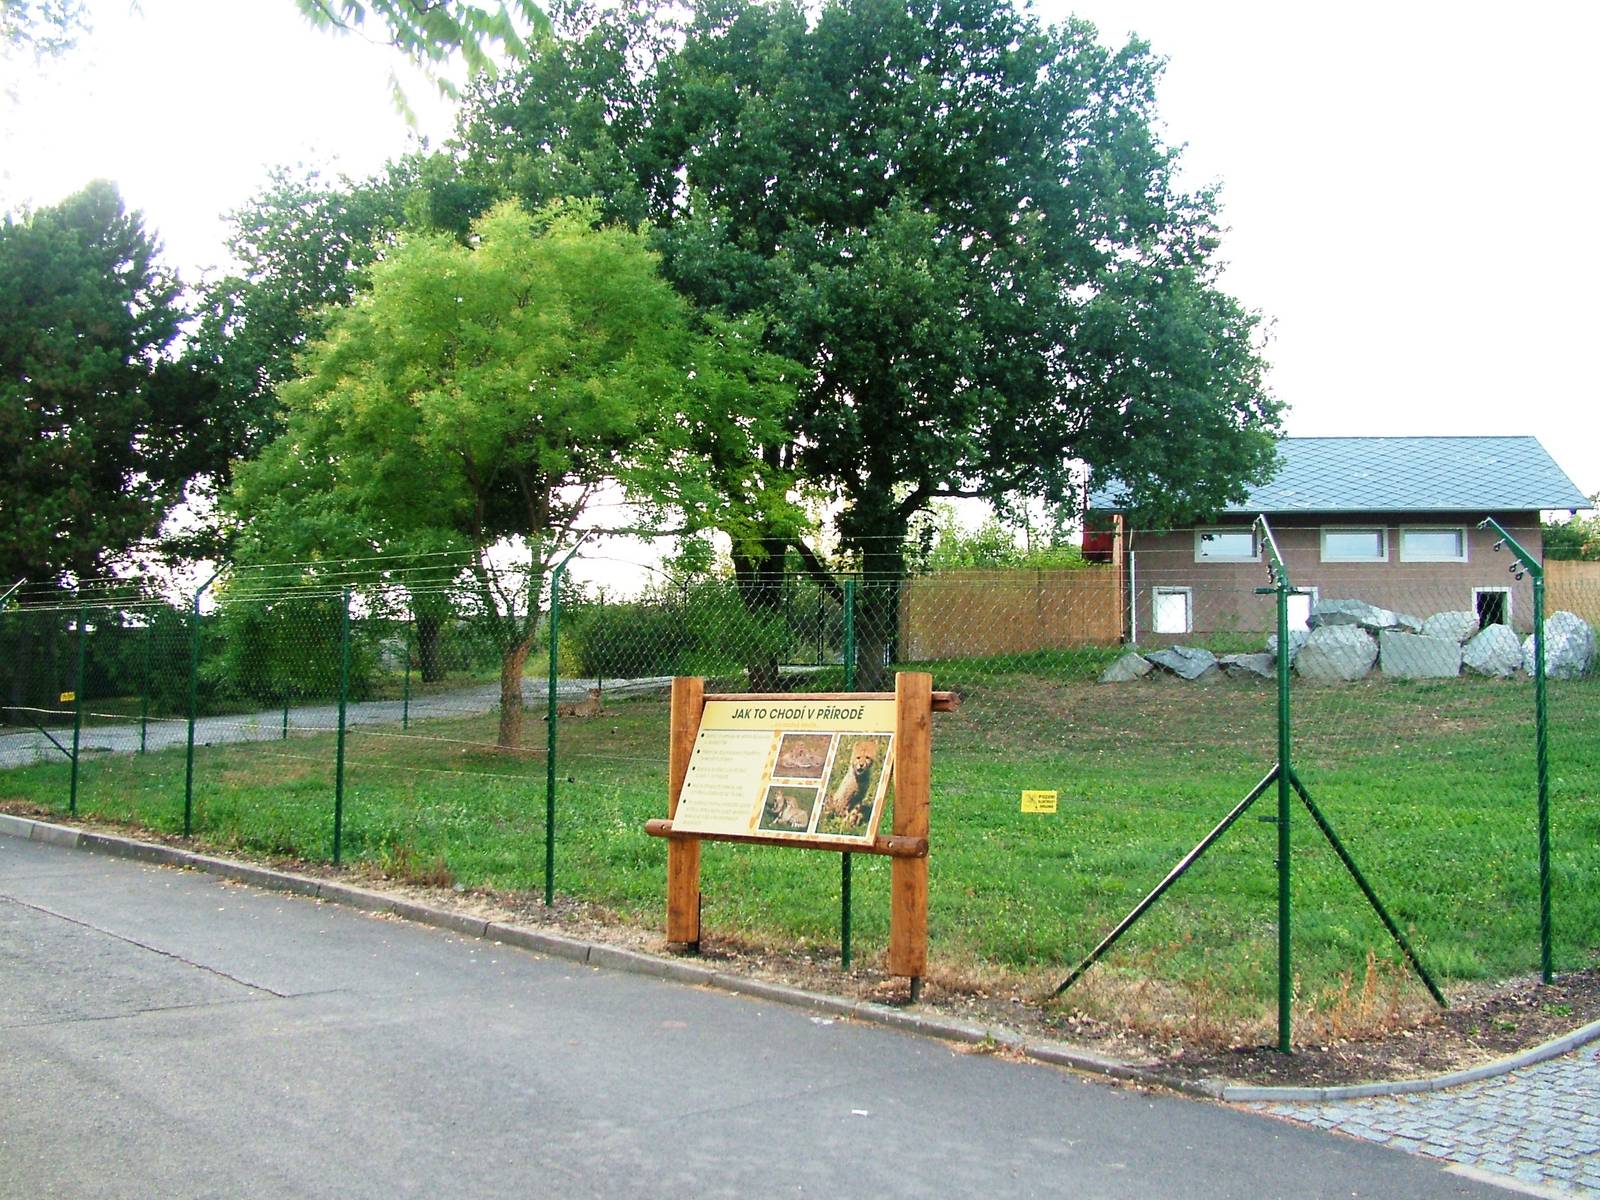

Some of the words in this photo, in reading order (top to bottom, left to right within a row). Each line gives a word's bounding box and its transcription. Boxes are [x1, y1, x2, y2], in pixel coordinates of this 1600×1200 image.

[731, 708, 752, 719] JAK
[754, 708, 767, 719] TO
[769, 705, 807, 719] CHODÍ
[808, 708, 815, 719] V
[816, 705, 864, 719] PŘÍRODĚ
